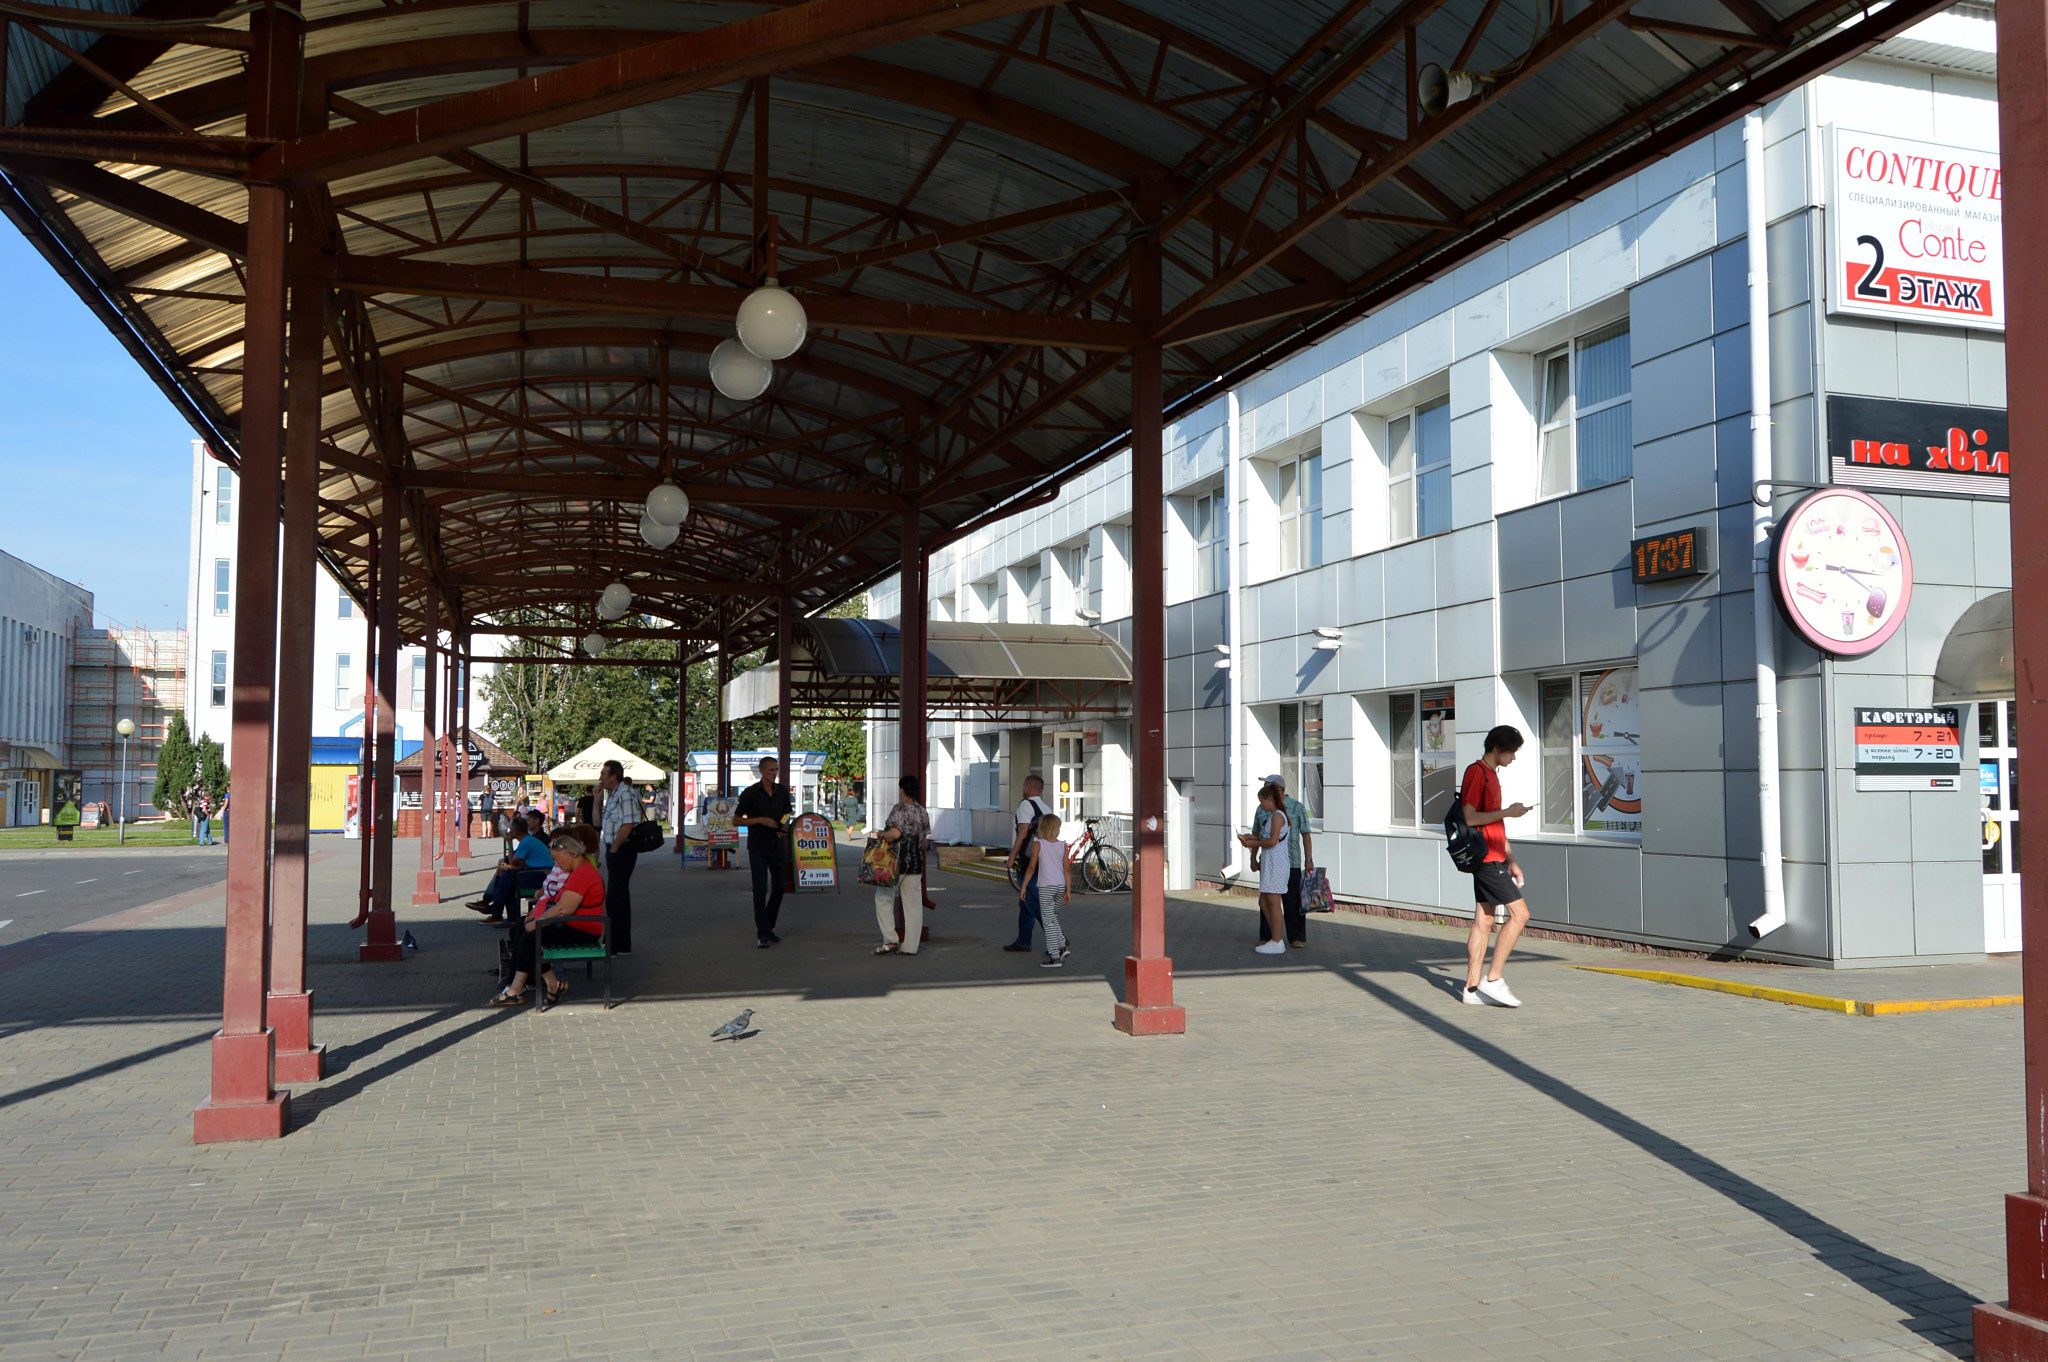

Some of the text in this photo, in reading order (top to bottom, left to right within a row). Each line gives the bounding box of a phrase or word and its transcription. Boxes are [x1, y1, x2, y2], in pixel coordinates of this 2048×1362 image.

[1848, 191, 1961, 217] СПЕЦИАЛИЗИРОВАННЫЙ
[1899, 219, 1987, 264] Conte
[1856, 234, 1981, 310] 2 ЭТАЖ
[1852, 438, 1911, 466] на
[1635, 533, 1693, 577] 17:37
[1861, 710, 1955, 724] КАФЕТЭРЫЙ
[1913, 731, 1923, 742] 7
[1936, 731, 1952, 742] 21
[1914, 748, 1923, 760] 7
[1935, 748, 1954, 760] 20
[802, 817, 813, 833] 5
[797, 838, 828, 850] ФОТО
